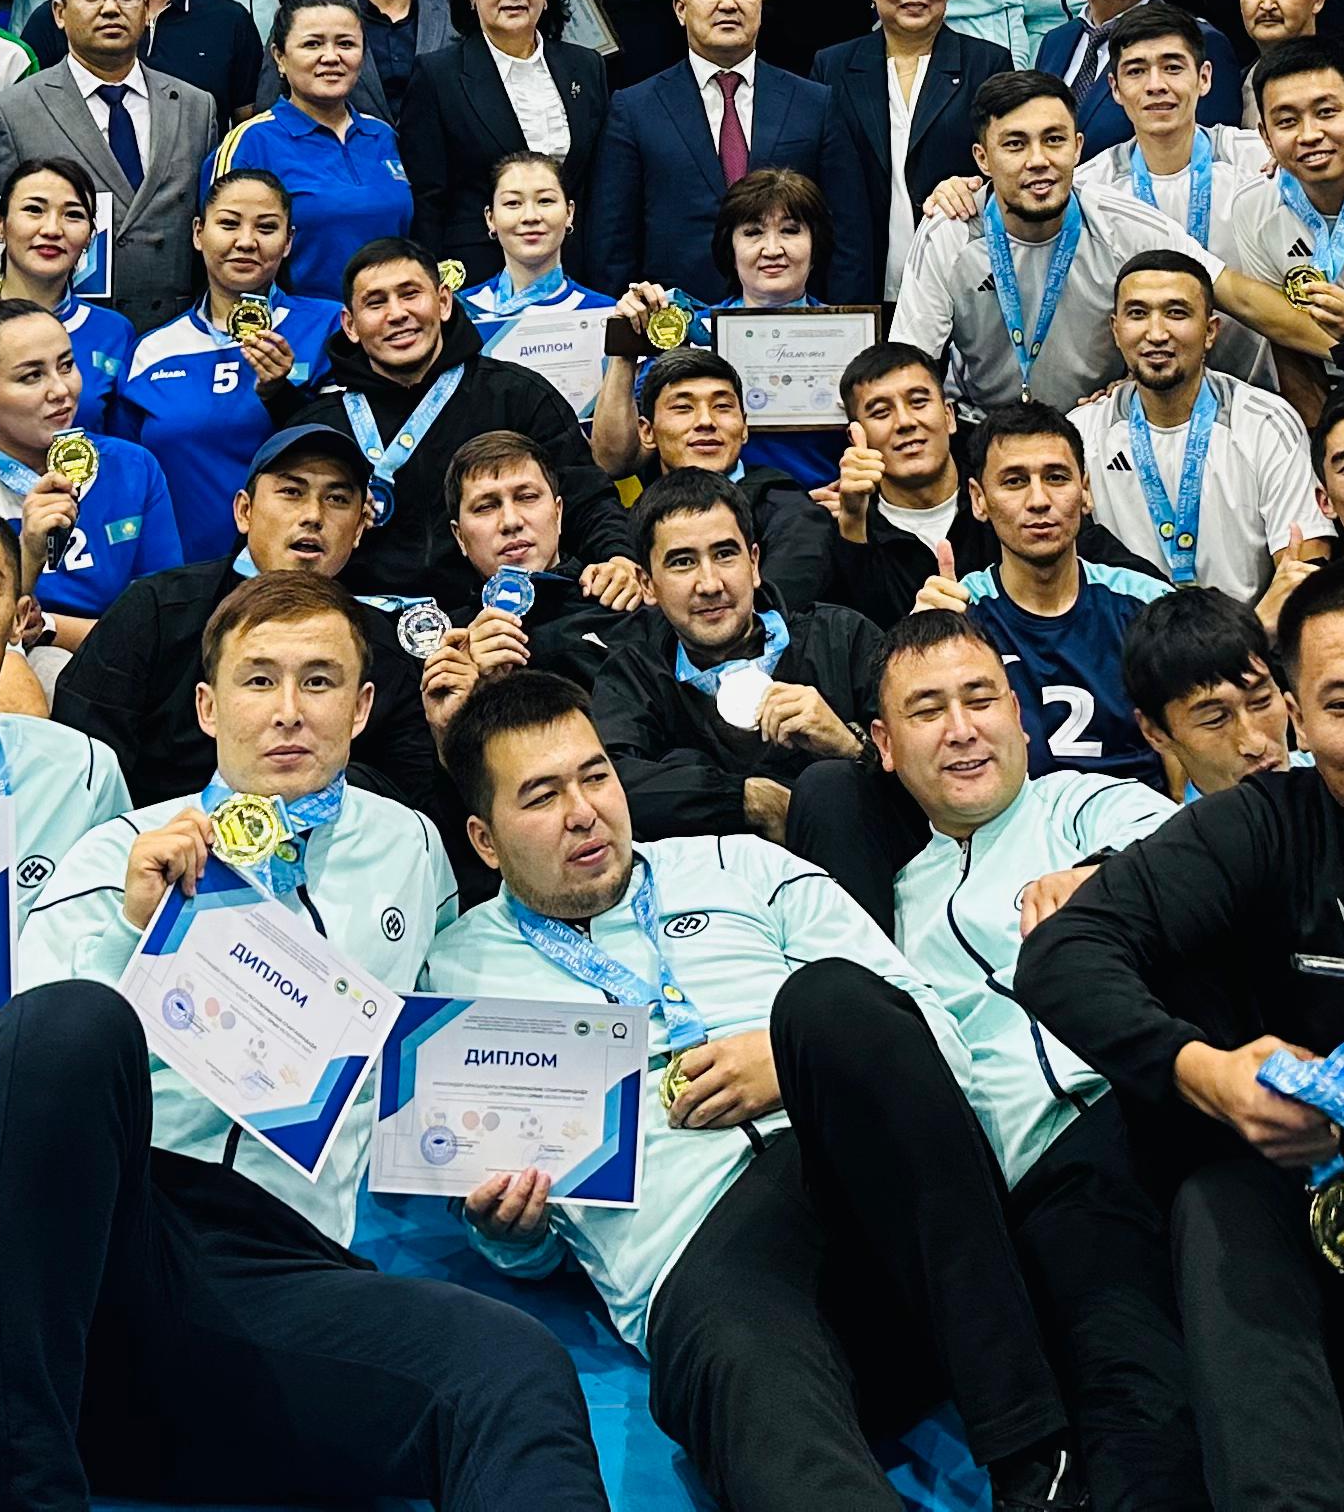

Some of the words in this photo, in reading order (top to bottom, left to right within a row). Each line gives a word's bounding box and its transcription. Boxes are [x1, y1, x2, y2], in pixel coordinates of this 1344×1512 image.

[520, 342, 573, 357] ДИПЛОМ
[213, 361, 240, 394] 5
[1041, 685, 1102, 757] 2
[230, 942, 309, 1008] ДИПЛОМ
[464, 1049, 557, 1068] ДИПЛОМ
